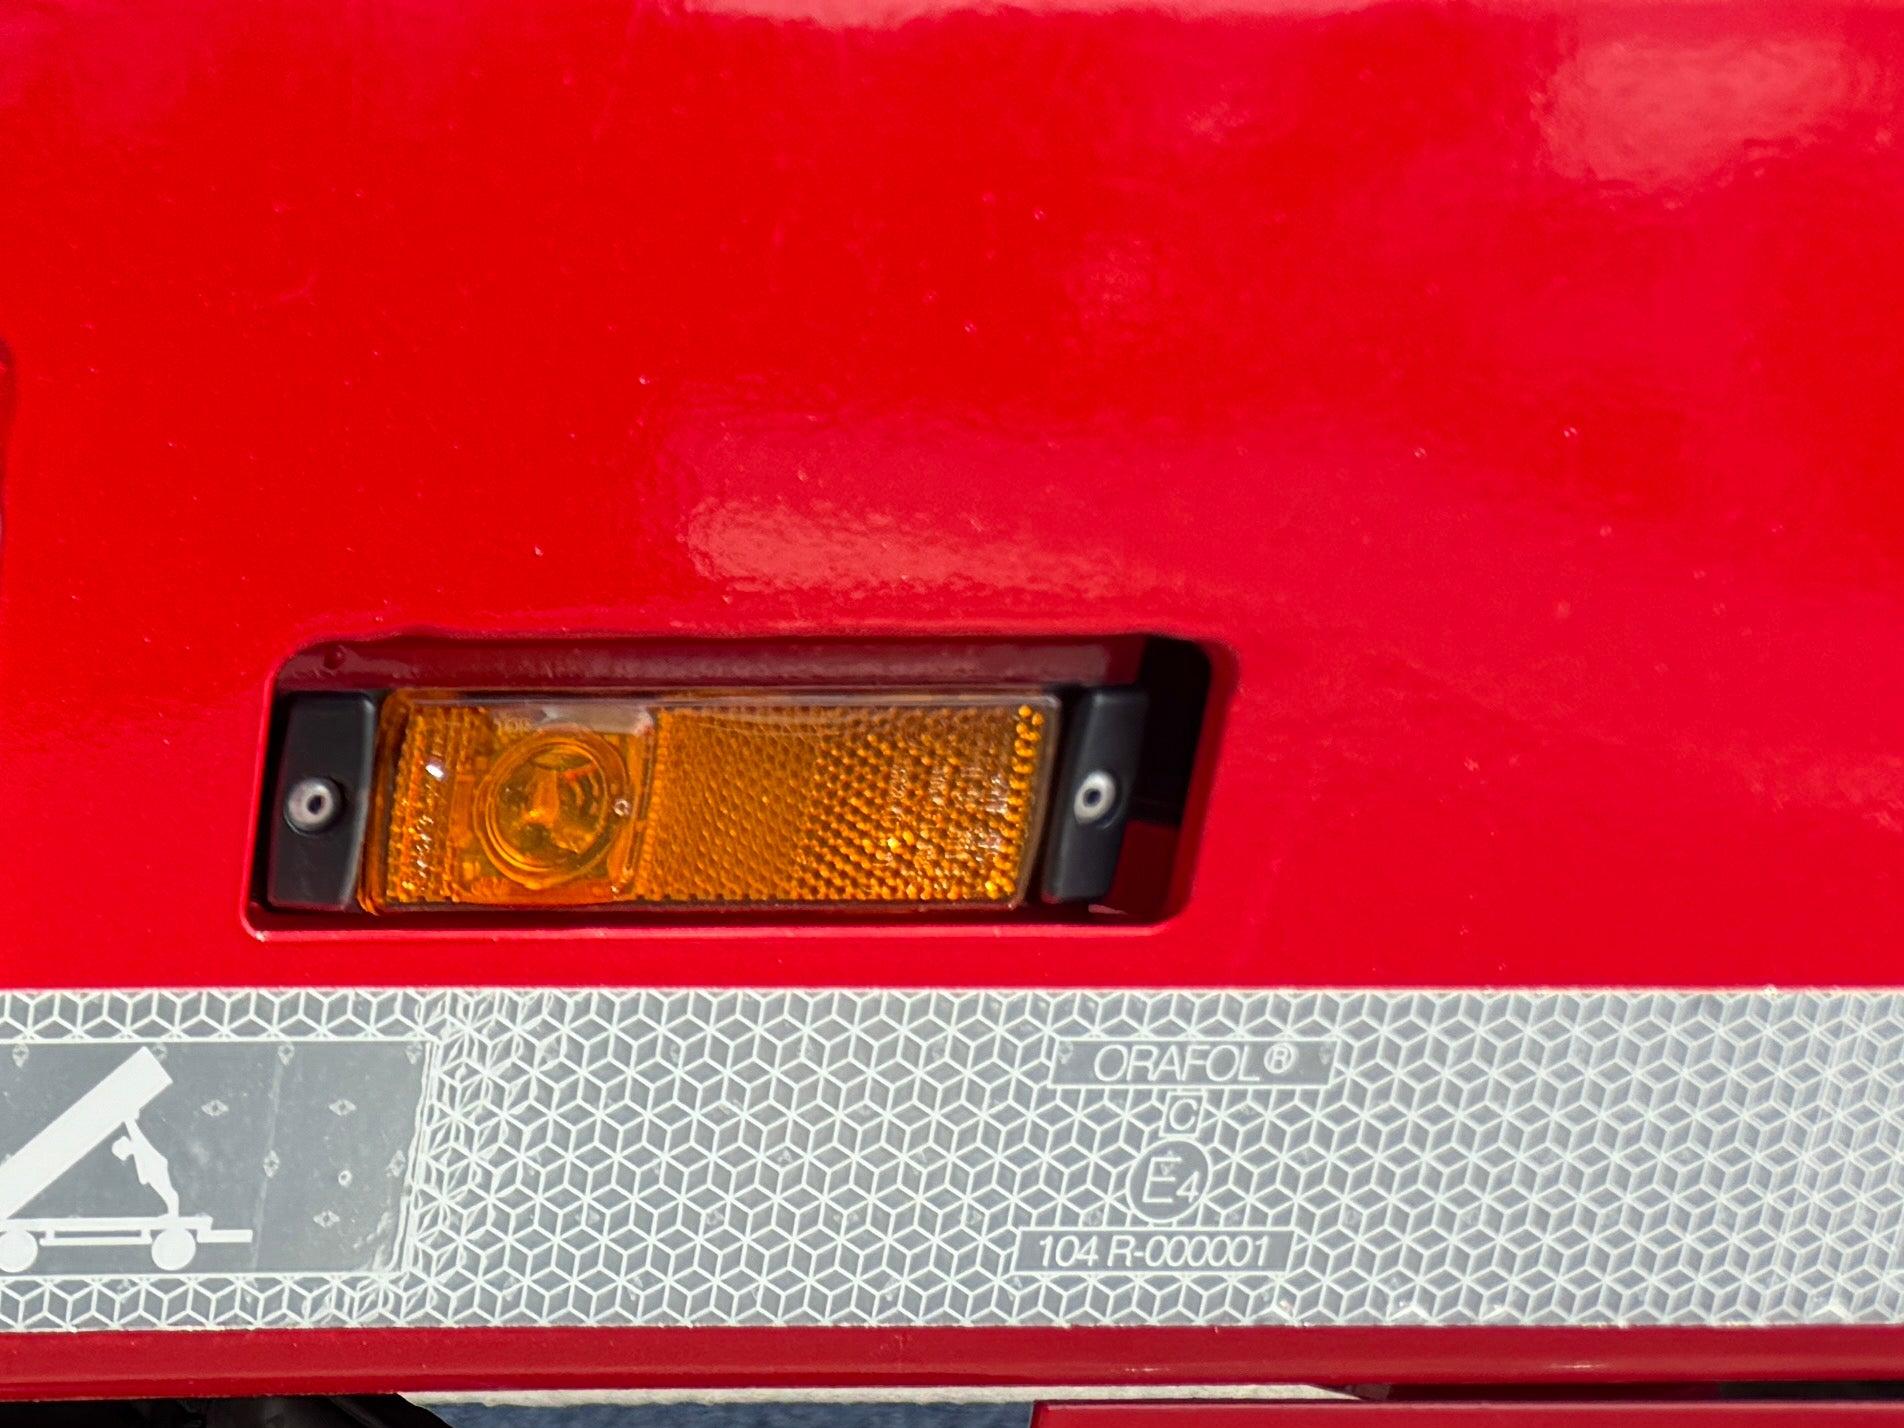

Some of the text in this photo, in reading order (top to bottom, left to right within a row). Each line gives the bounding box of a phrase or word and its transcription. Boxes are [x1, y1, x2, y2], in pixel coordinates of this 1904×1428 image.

[1169, 1098, 1199, 1131] C
[1039, 1235, 1271, 1268] 104 R-000001
